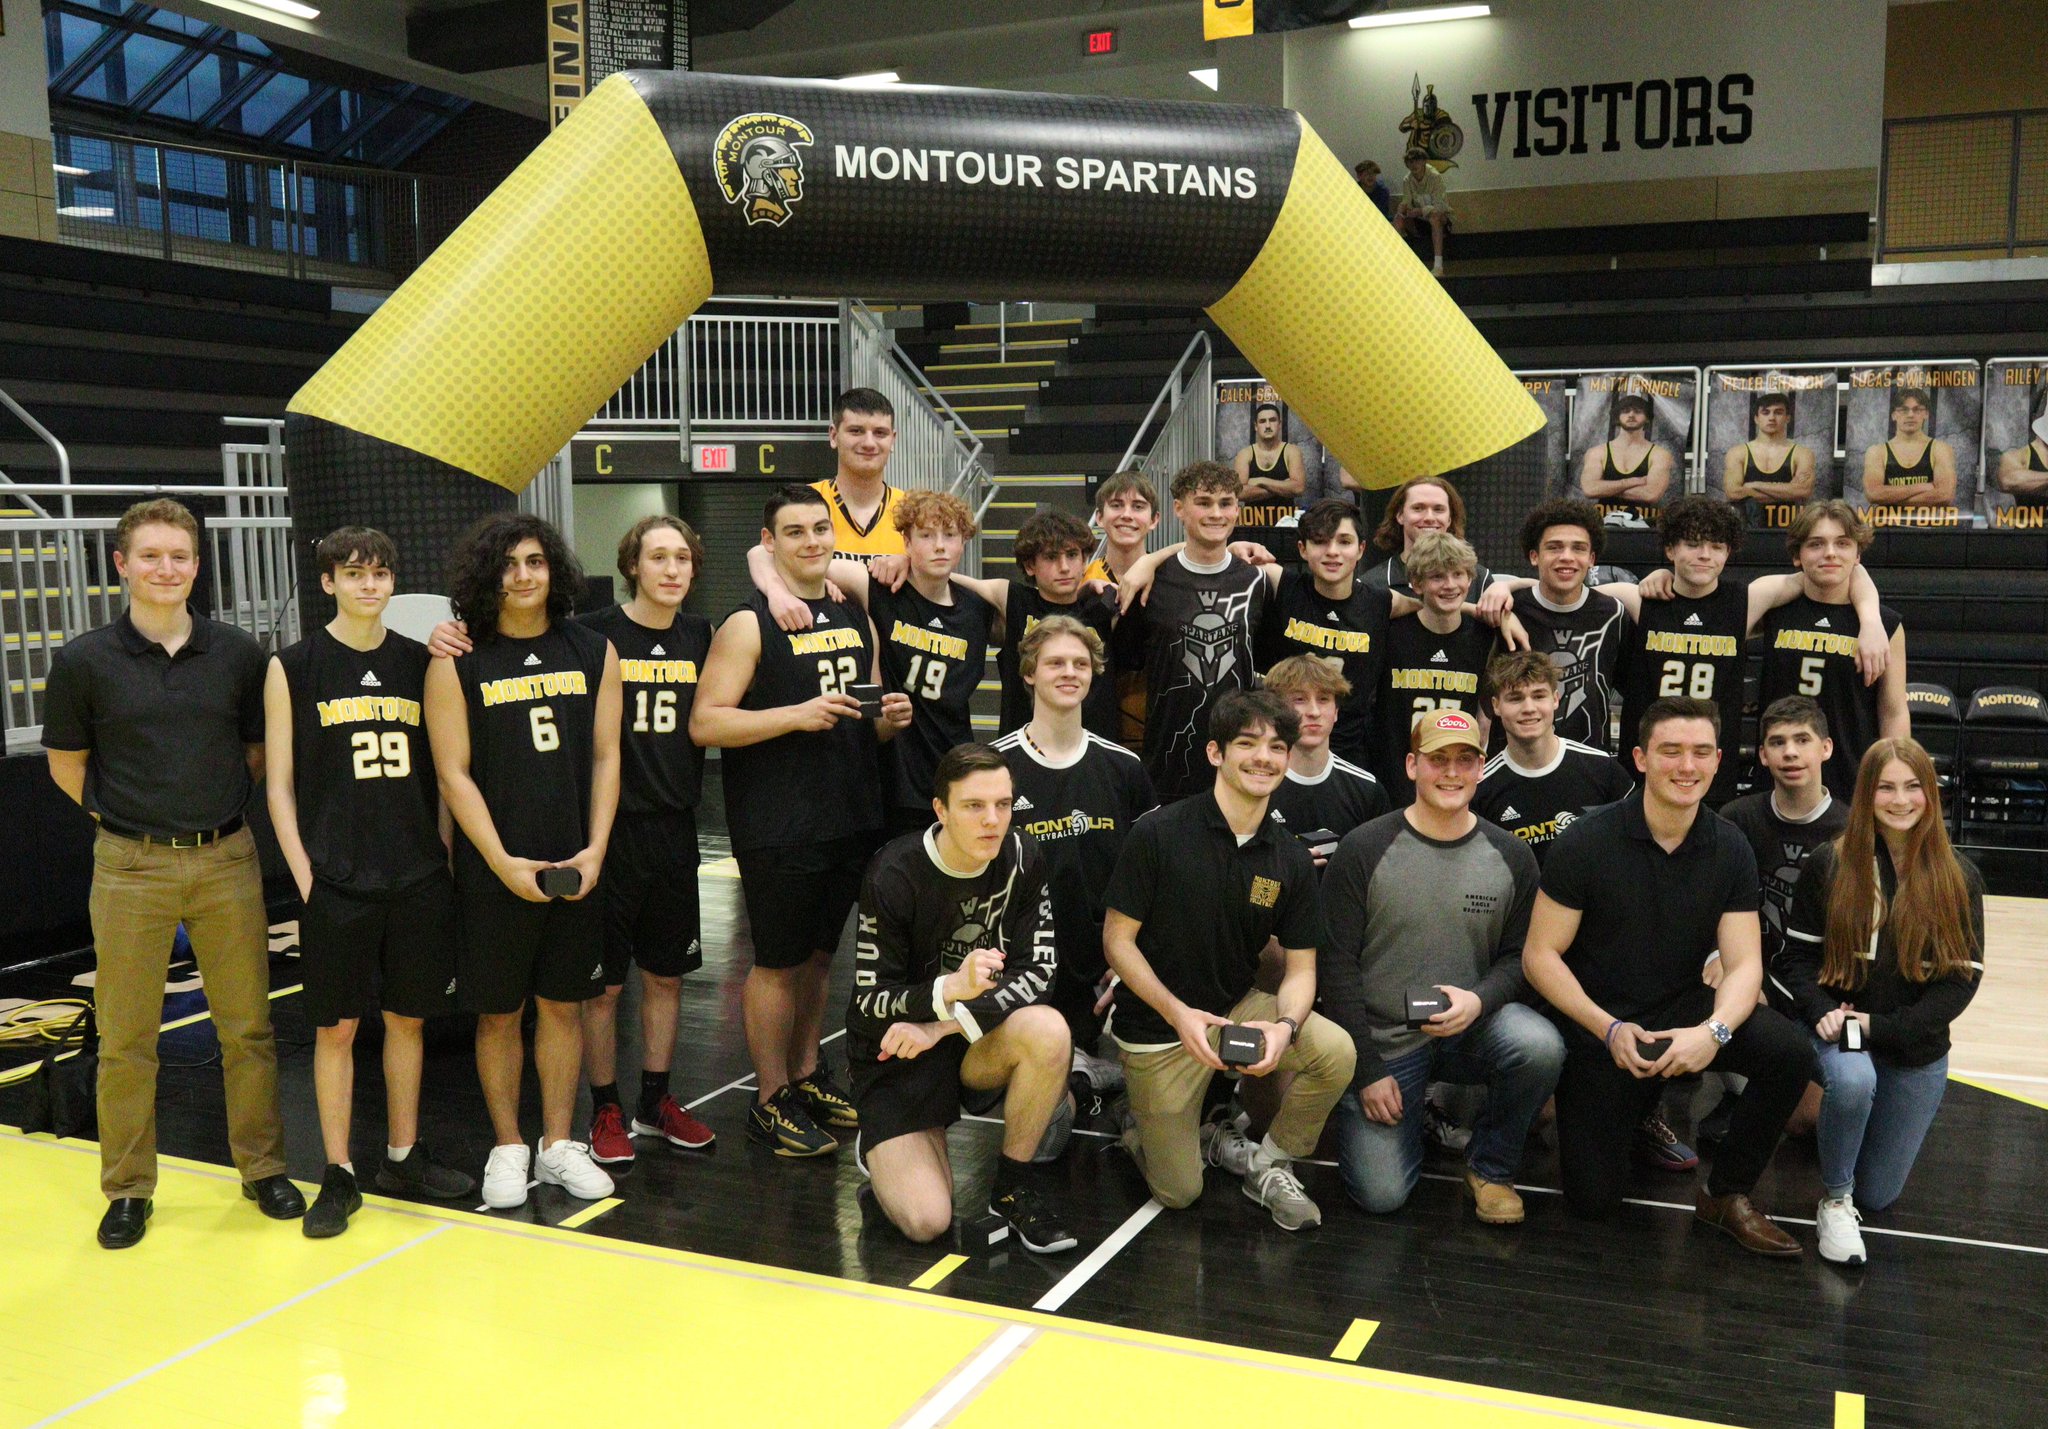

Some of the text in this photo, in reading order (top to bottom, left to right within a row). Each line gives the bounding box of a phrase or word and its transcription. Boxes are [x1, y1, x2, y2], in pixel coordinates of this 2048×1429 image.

[590, 5, 608, 13] BOYS
[610, 8, 658, 17] VOLLEYBALL
[610, 1, 642, 9] BOWLING
[590, 12, 610, 20] GIRLS
[612, 16, 642, 24] BOWLING
[590, 20, 608, 28] BOYS
[610, 22, 640, 31] BOWLING
[590, 27, 626, 37] SOFTBALL
[590, 34, 611, 42] GIRLS
[614, 37, 661, 46] BASKETBALL
[1089, 32, 1112, 53] EXIT
[590, 42, 611, 50] GIRLS
[614, 44, 651, 53] SWIMMING
[591, 48, 612, 57] GIRLS
[614, 51, 661, 61] BASKETBALL
[591, 56, 627, 66] SOFTBALL
[1472, 73, 1754, 160] VISITORS
[728, 125, 786, 162] MONTOUR
[835, 145, 1257, 199] MONTOUR SPARTANS
[1590, 376, 1682, 398] MATTI PRINGLE
[1723, 377, 1763, 391] PETER
[1852, 370, 1976, 388] LUCAS SWEARINGEN
[2005, 367, 2041, 385] RILEY
[1220, 387, 1252, 403] CALEN
[1523, 382, 1552, 395] PPY
[596, 444, 613, 475] C
[701, 447, 728, 469] EXIT
[758, 443, 776, 474] C
[1858, 505, 1959, 528] MONTOUR
[1996, 505, 2048, 528] MON
[787, 627, 864, 656] MONTOUR
[890, 619, 969, 662] MONTOUR
[1180, 622, 1239, 643] SPARTANS
[1284, 617, 1370, 653] MONTOUR
[1645, 630, 1737, 656] MONTOUR
[817, 656, 858, 695] 22
[903, 654, 948, 700] 19
[1391, 668, 1479, 694] MONTOUR
[1659, 660, 1715, 699] 28
[1798, 656, 1822, 696] 5
[480, 670, 587, 707] MONTOUR
[316, 695, 421, 727] MONTOUR
[633, 690, 677, 733] 16
[1978, 694, 2040, 708] MONTOUR
[529, 705, 561, 752] 6
[1439, 717, 1468, 728] Coors
[351, 730, 411, 779] 29
[1527, 832, 1555, 845] YBALL
